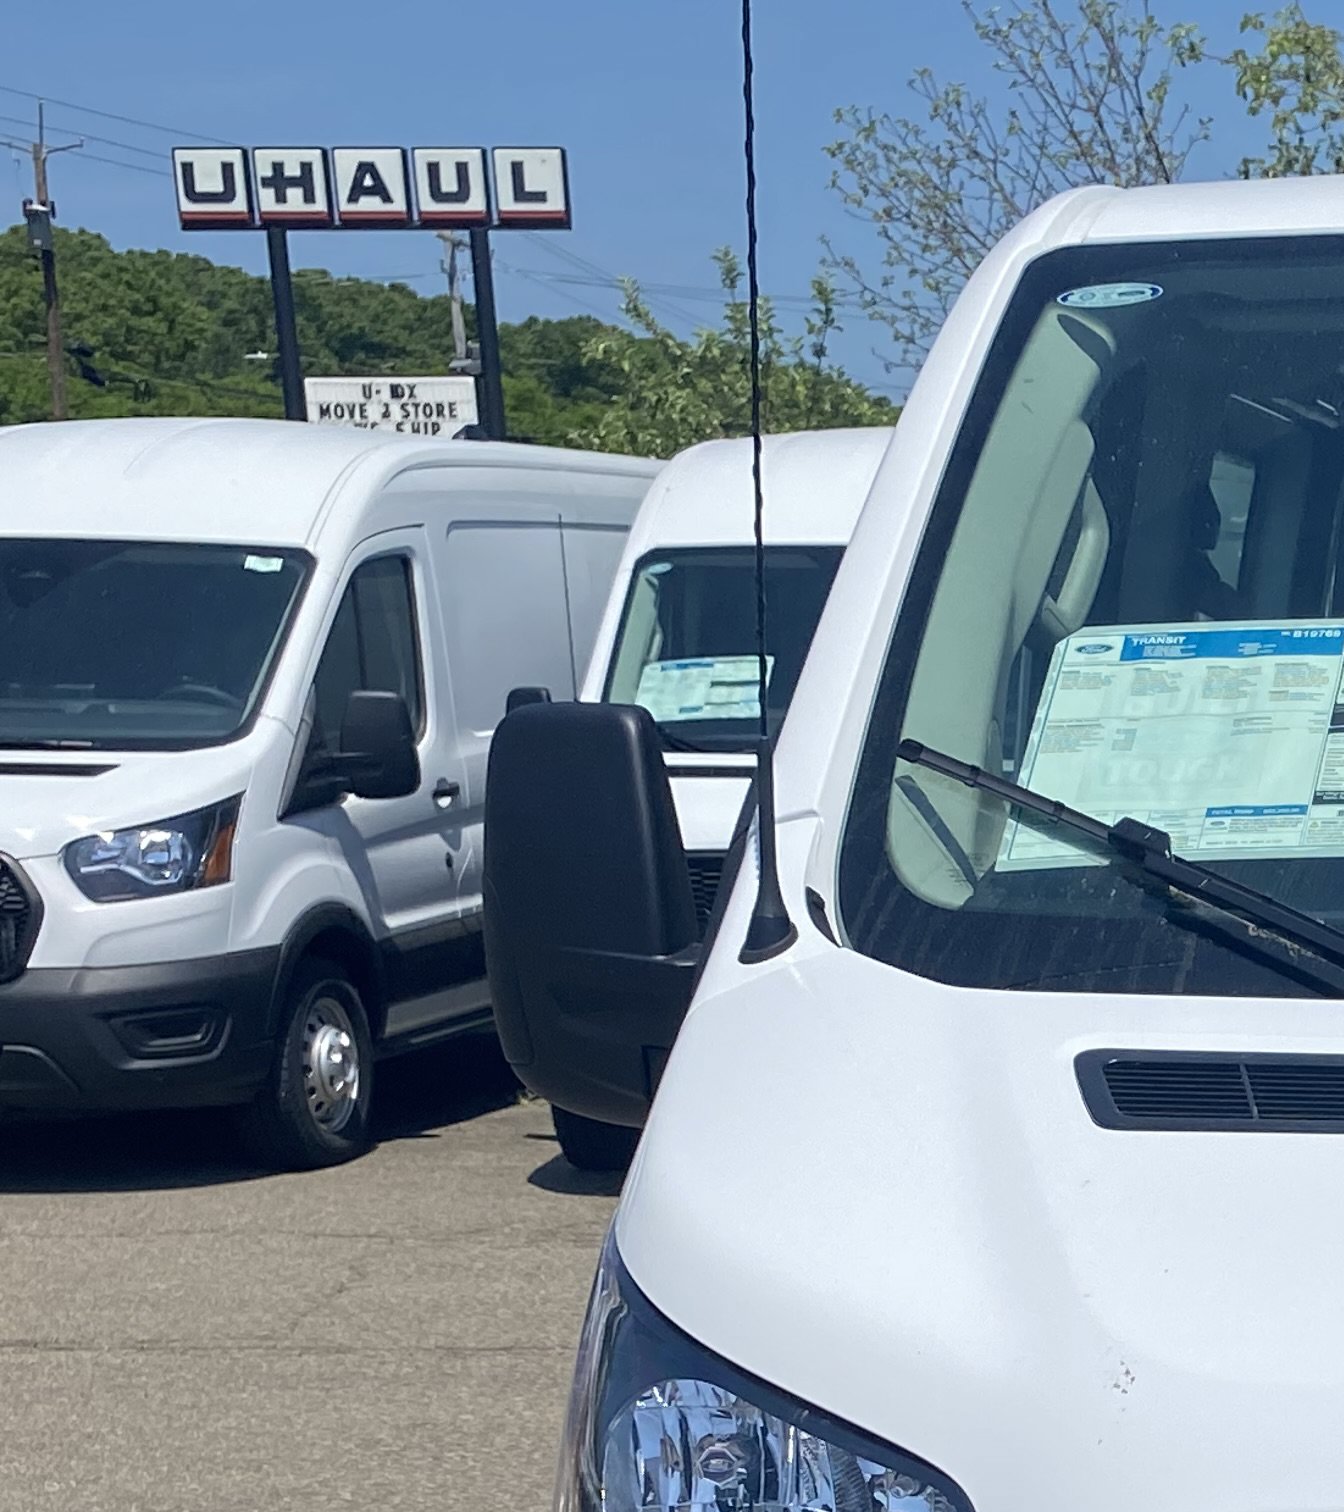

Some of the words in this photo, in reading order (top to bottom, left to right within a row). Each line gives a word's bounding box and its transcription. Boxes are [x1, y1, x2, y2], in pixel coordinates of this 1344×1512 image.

[319, 403, 368, 419] MOVE
[400, 402, 457, 419] STORE
[1131, 636, 1186, 647] TRANSIT
